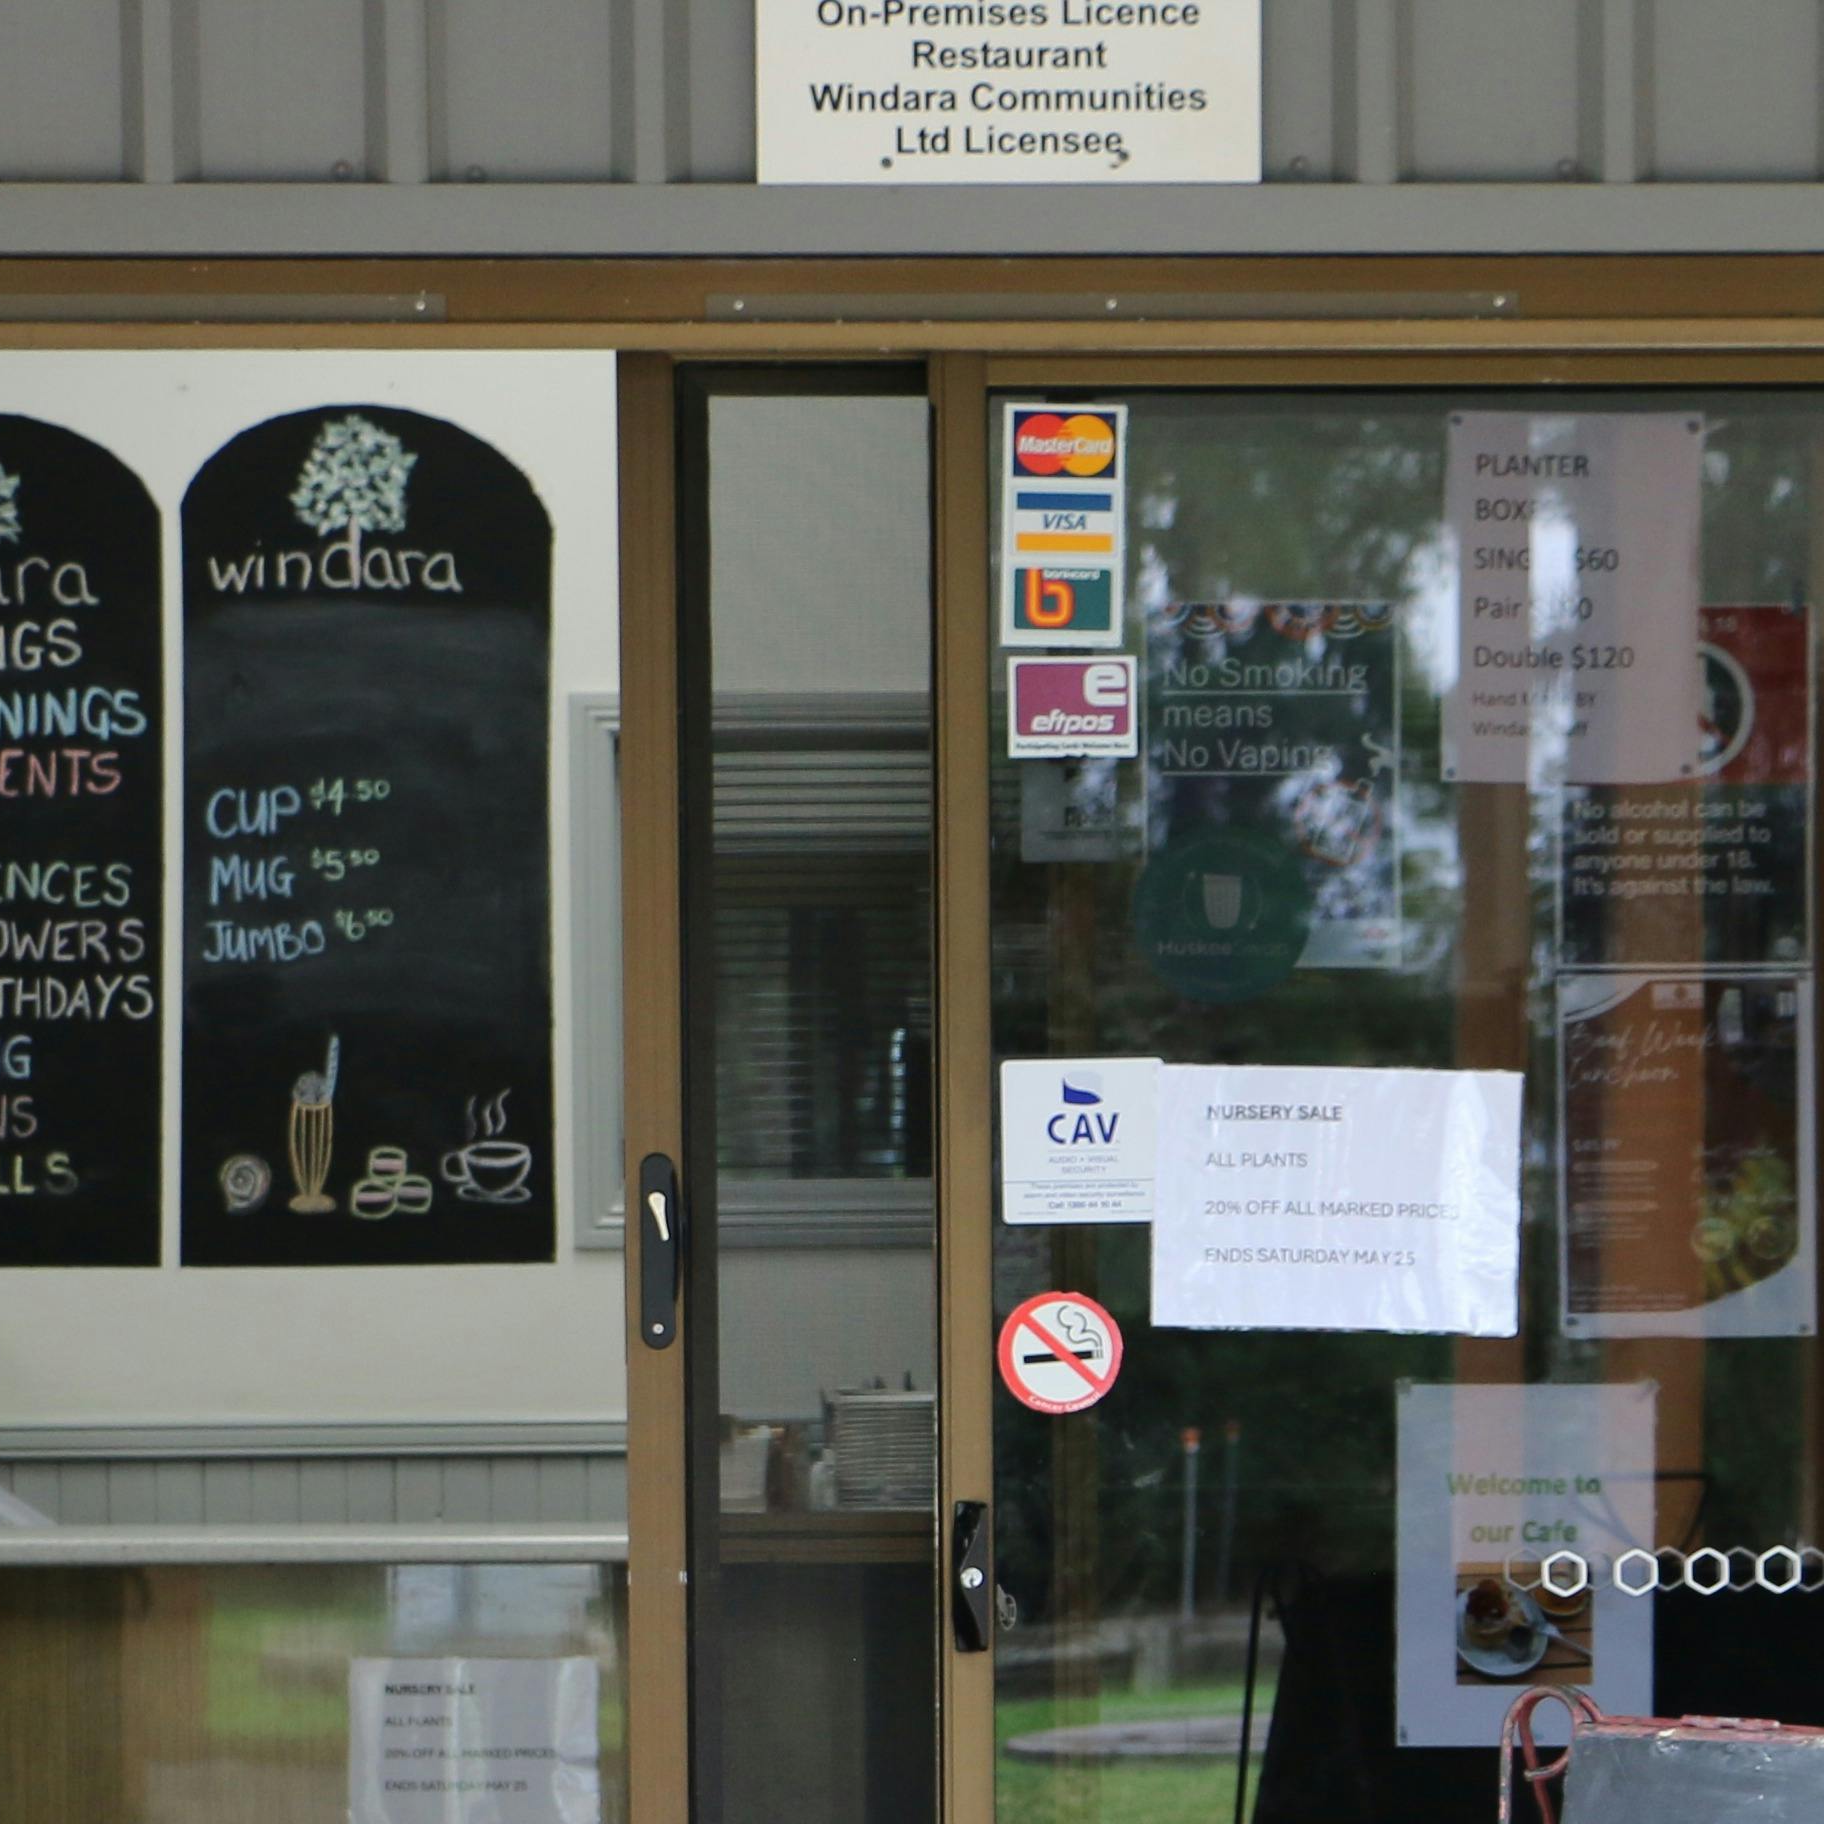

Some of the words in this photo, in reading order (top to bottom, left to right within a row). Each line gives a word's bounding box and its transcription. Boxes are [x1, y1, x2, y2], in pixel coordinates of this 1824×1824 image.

[817, 0, 1048, 26] On-Premises
[1062, 0, 1200, 26] Licence
[912, 40, 1108, 69] Restaurant
[810, 83, 957, 112] Windara
[971, 82, 1208, 112] Communities
[896, 126, 950, 154] Ltd
[965, 126, 1123, 155] Licensee
[1018, 436, 1114, 454] MasterCard
[1475, 453, 1590, 478] PLANTER
[1043, 513, 1087, 530] VISA
[207, 526, 463, 593] windara
[1473, 597, 1524, 621] Pair
[1473, 646, 1565, 670] Double
[1570, 645, 1635, 671] $120
[1161, 659, 1207, 688] No
[1219, 657, 1369, 693] Smoking
[1031, 708, 1115, 735] eftpos
[1161, 703, 1274, 729] means
[1161, 739, 1206, 768] No
[1217, 738, 1334, 774] Vaping
[205, 785, 302, 840] CUP
[1573, 801, 1605, 820] No
[1610, 799, 1690, 820] alcohol
[1695, 804, 1734, 820] can
[1738, 800, 1767, 820] be
[1624, 829, 1649, 846] or
[1748, 826, 1772, 845] to
[209, 853, 297, 906] MUG
[201, 919, 326, 964] JUMBO
[1206, 1104, 1293, 1121] NURSERY
[1298, 1104, 1344, 1121] SALE
[1047, 1112, 1119, 1144] CAV
[1205, 1152, 1237, 1168] ALL
[1241, 1152, 1309, 1168] PLANTS
[1204, 1200, 1242, 1216] 20%
[1246, 1200, 1281, 1216] OFF
[1284, 1200, 1315, 1216] ALL
[1319, 1201, 1394, 1218] MARKED
[1205, 1248, 1254, 1264] ENDS
[1256, 1248, 1350, 1265] SATURDAY
[1353, 1249, 1390, 1265] MAY
[1393, 1250, 1416, 1266] 25
[1446, 1472, 1566, 1497] Welcome
[1575, 1474, 1602, 1496] to
[1470, 1524, 1514, 1544] our
[1522, 1520, 1579, 1544] Cafe
